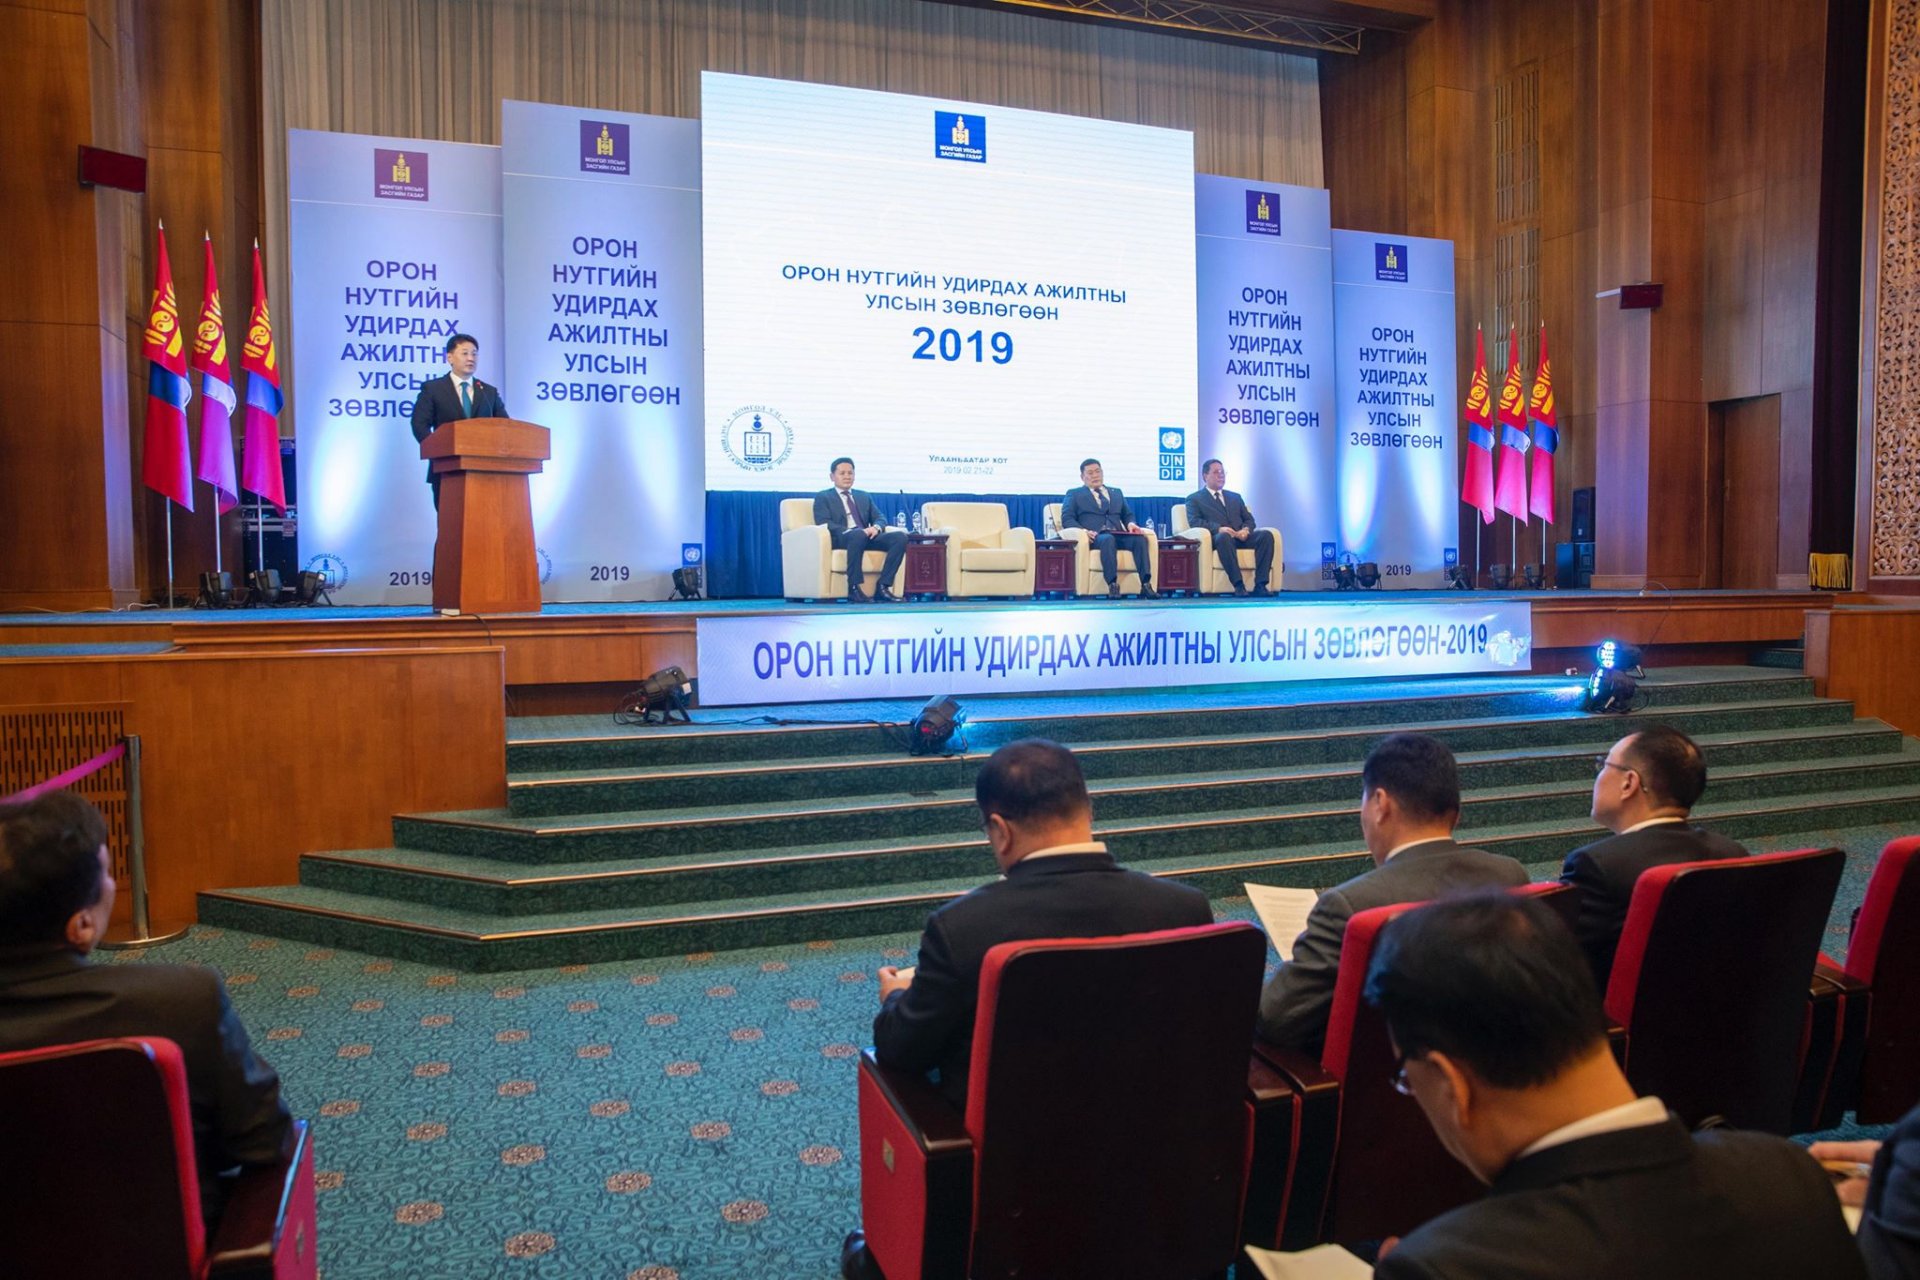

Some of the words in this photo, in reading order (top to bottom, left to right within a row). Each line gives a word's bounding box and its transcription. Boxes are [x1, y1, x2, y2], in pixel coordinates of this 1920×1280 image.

[572, 236, 637, 259] ОРОН
[366, 259, 437, 282] ОРОН
[553, 264, 657, 289] НУТГИЙН
[782, 264, 840, 283] ОРОН
[846, 266, 936, 290] НУТГИЙН
[943, 275, 1027, 298] УДИРДАХ
[1033, 282, 1127, 303] АЖИЛТНЫ
[345, 286, 459, 310] НУТГИЙН
[553, 293, 658, 319] УДИРДАХ
[1242, 287, 1288, 306] ОРОН
[866, 294, 936, 313] УЛСЫН
[942, 298, 1059, 321] ЗӨВЛӨГӨӨН
[345, 315, 460, 339] УДИРДАХ
[1228, 310, 1302, 331] НУТГИЙН
[548, 323, 668, 347] АЖИЛТНЫ
[912, 325, 1014, 365] 2019
[1228, 334, 1303, 356] УДИРДАХ
[1372, 327, 1414, 344] ОРОН
[341, 343, 448, 364] АЖИЛТН
[565, 353, 647, 375] УЛСЫН
[1360, 348, 1427, 365] НУТГИЙН
[1226, 359, 1310, 379] АЖИЛТНЫ
[1360, 368, 1428, 386] УДИРДАХ
[536, 381, 681, 406] ЗӨВЛӨГӨӨН
[1238, 384, 1296, 402] УЛСЫН
[1357, 390, 1434, 407] АЖИЛТНЫ
[329, 398, 415, 419] ЗӨВЛӨ
[1218, 408, 1319, 427] ЗӨВЛӨГӨӨН
[1368, 412, 1421, 427] УЛСЫН
[1350, 432, 1442, 449] ЗӨВЛӨГӨӨН
[390, 571, 432, 587] 2019
[590, 566, 630, 581] 2019
[1386, 565, 1411, 576] 2019
[753, 640, 833, 680] ОРОН
[843, 627, 965, 675] НУТГИЙН
[974, 633, 1090, 678] УДИРДАХ
[1096, 631, 1220, 667] АЖИЛТНЫ
[1228, 626, 1307, 664] УЛСЫН
[1313, 623, 1488, 659] ЗӨВЛӨГӨӨН-2019
